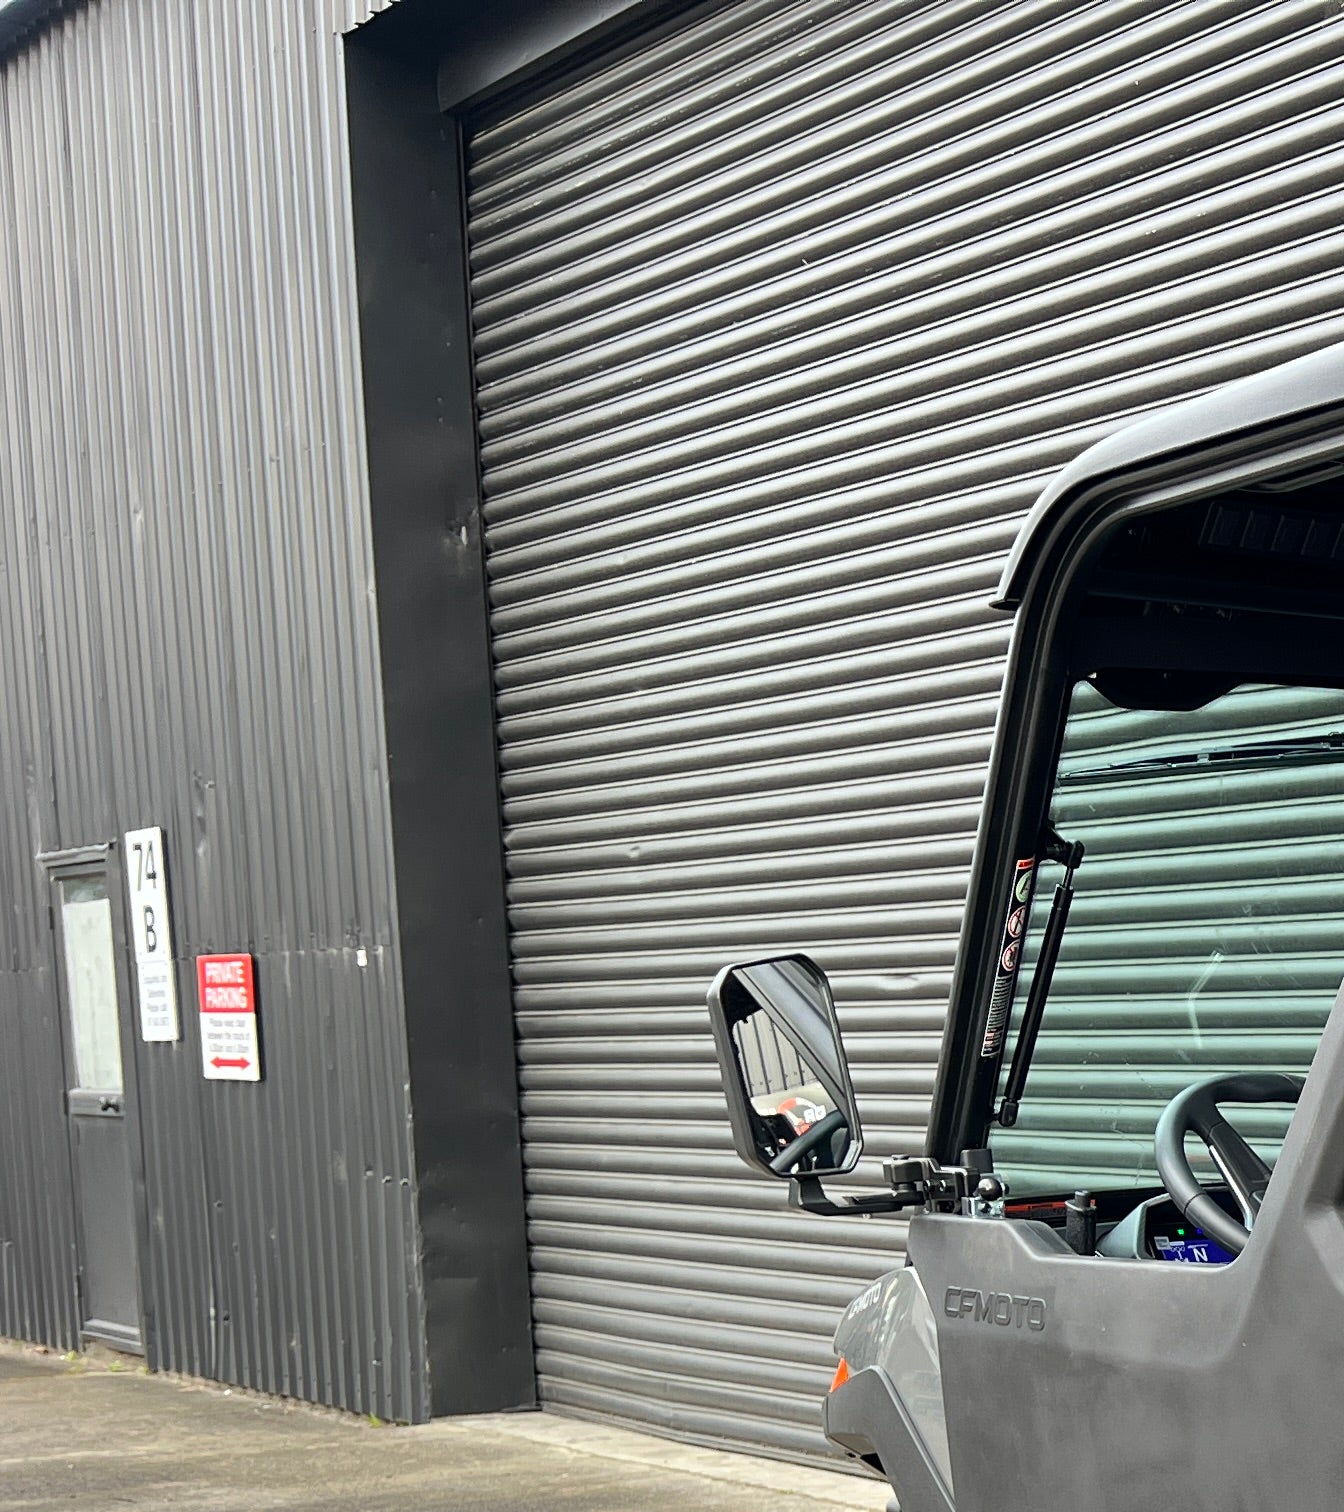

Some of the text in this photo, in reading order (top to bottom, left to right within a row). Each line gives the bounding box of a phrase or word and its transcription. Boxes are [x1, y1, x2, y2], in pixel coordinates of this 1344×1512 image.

[132, 840, 157, 892] 74
[143, 905, 158, 953] B
[205, 961, 245, 984] PRIVATE
[205, 986, 248, 1009] PARKING
[1192, 1247, 1209, 1262] N
[943, 1285, 1048, 1332] CFMOTO
